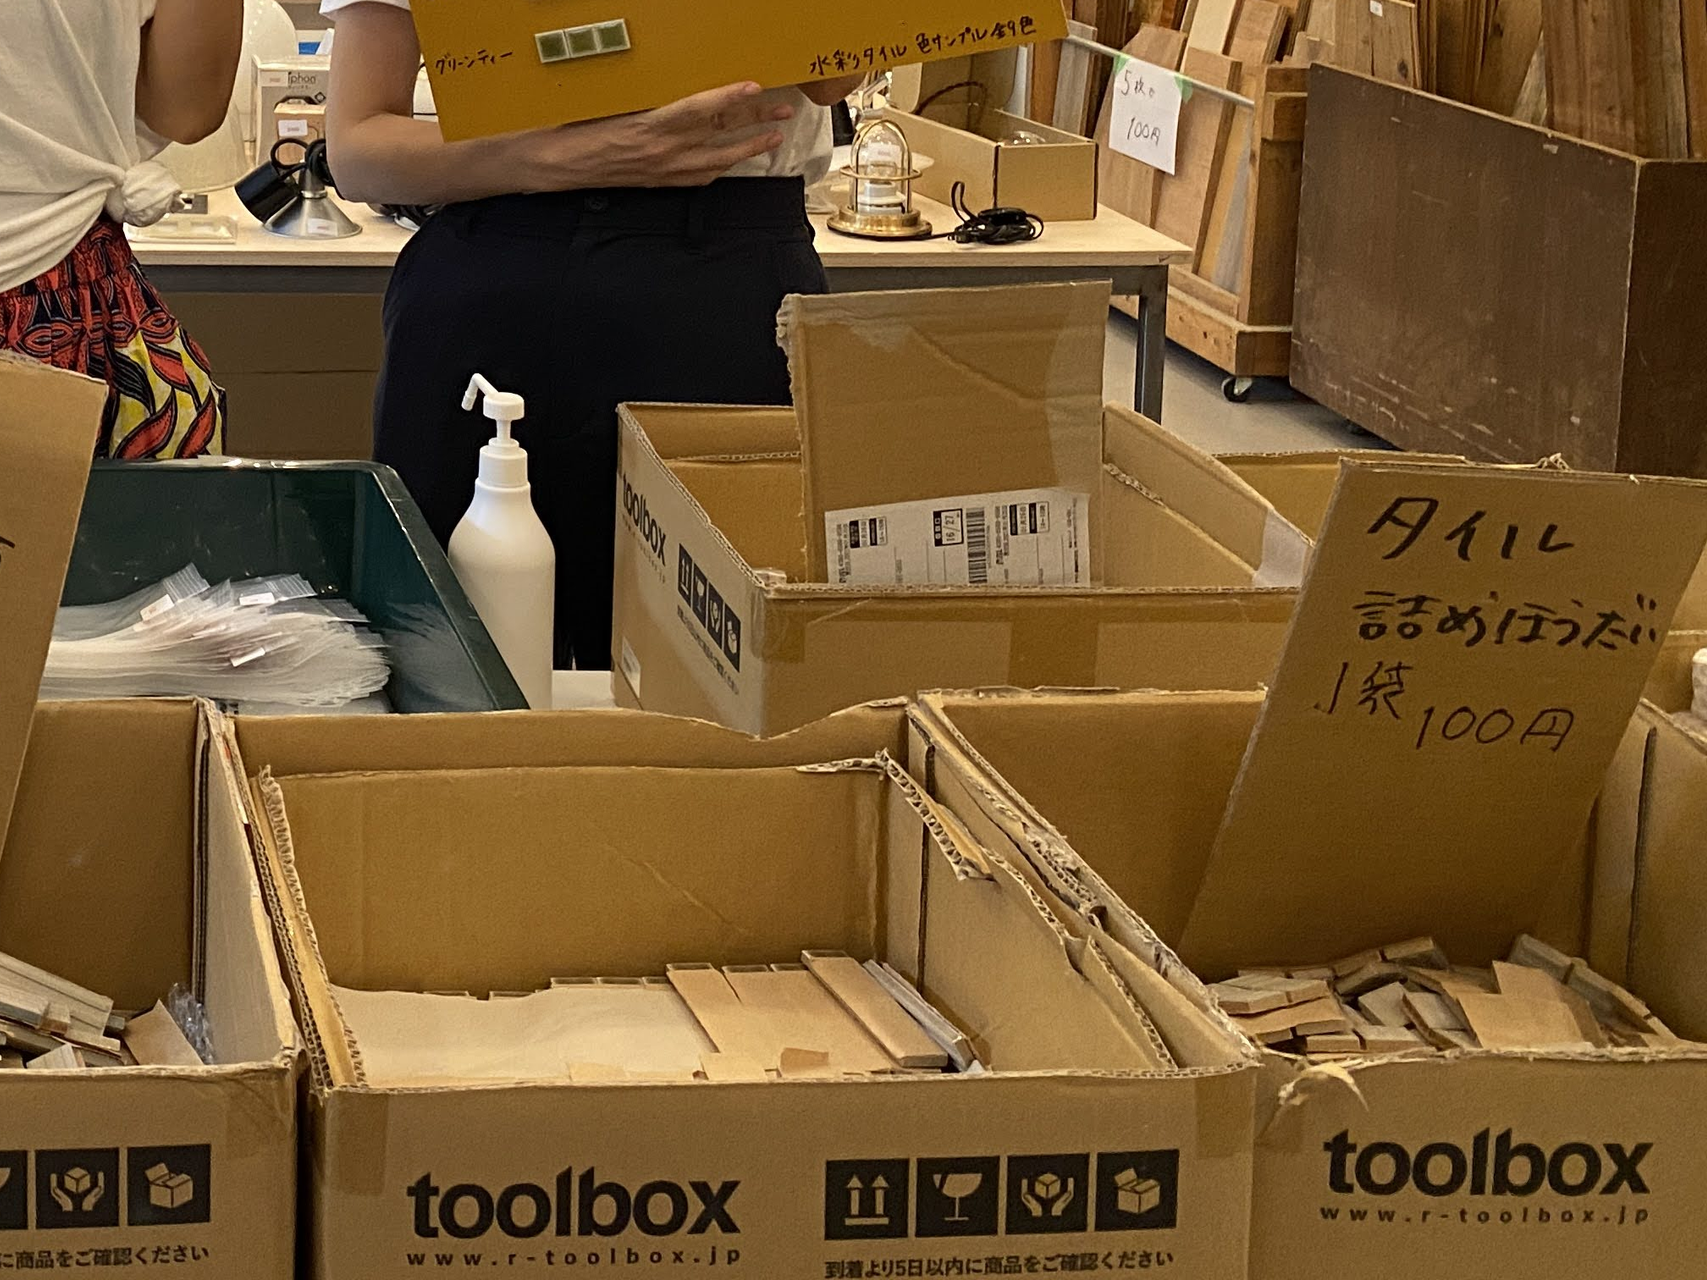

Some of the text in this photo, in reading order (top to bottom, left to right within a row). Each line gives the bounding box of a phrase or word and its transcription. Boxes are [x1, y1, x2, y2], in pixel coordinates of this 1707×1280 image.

[1126, 117, 1161, 147] 100円
[622, 473, 667, 567] toolbox
[1367, 496, 1574, 561] タイル
[1323, 1127, 1654, 1196] toolbox
[406, 1166, 742, 1239] toolbox
[1320, 1205, 1650, 1226] www.r-toolbox.jp
[406, 1246, 742, 1267] www.r-toolbox.jp
